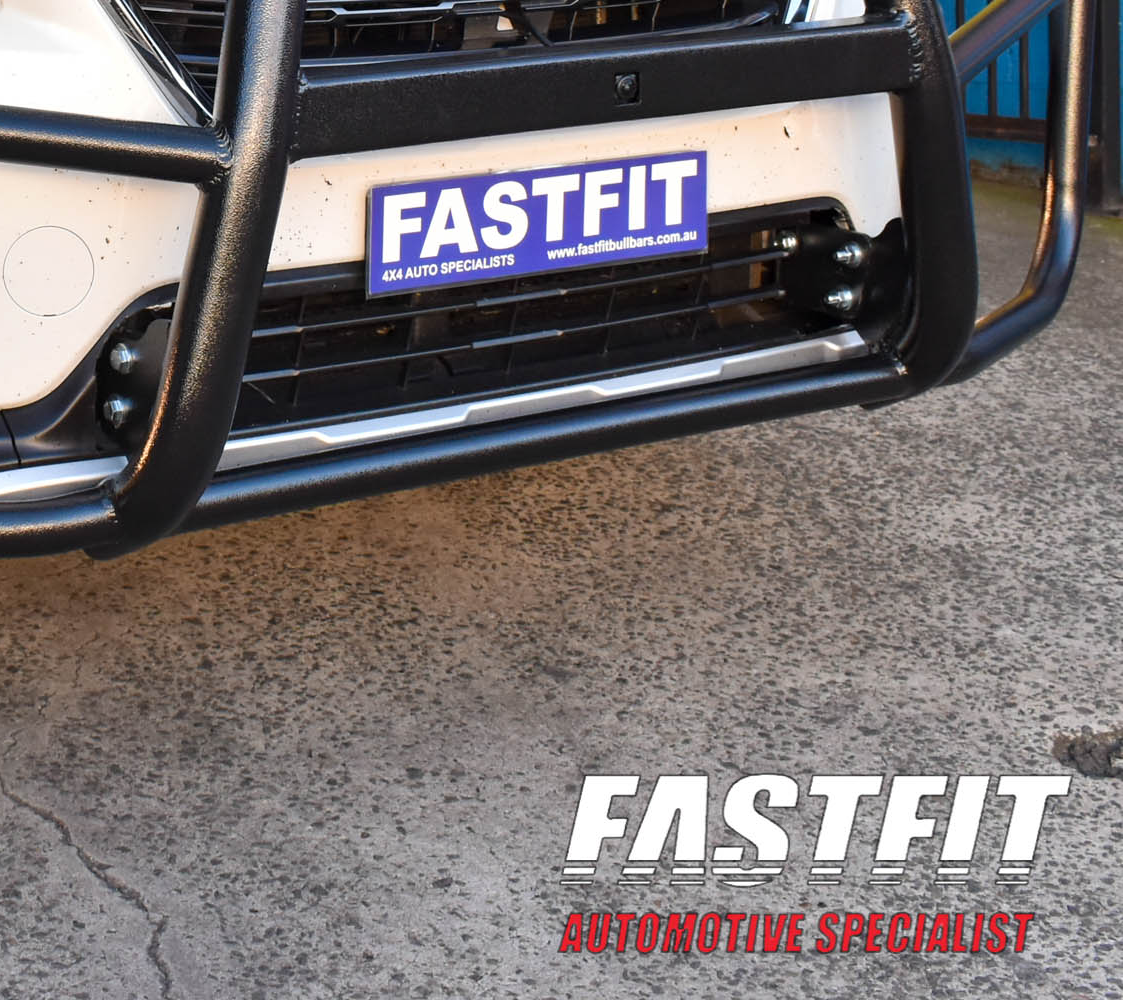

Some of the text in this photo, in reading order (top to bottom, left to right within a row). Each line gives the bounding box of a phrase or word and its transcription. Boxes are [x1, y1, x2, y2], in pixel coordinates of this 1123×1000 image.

[381, 158, 698, 264] FASTFIT
[546, 228, 698, 261] www.fastfitbullbars.com.au
[381, 253, 515, 282] 4X4 AUTO SPECIALISTS
